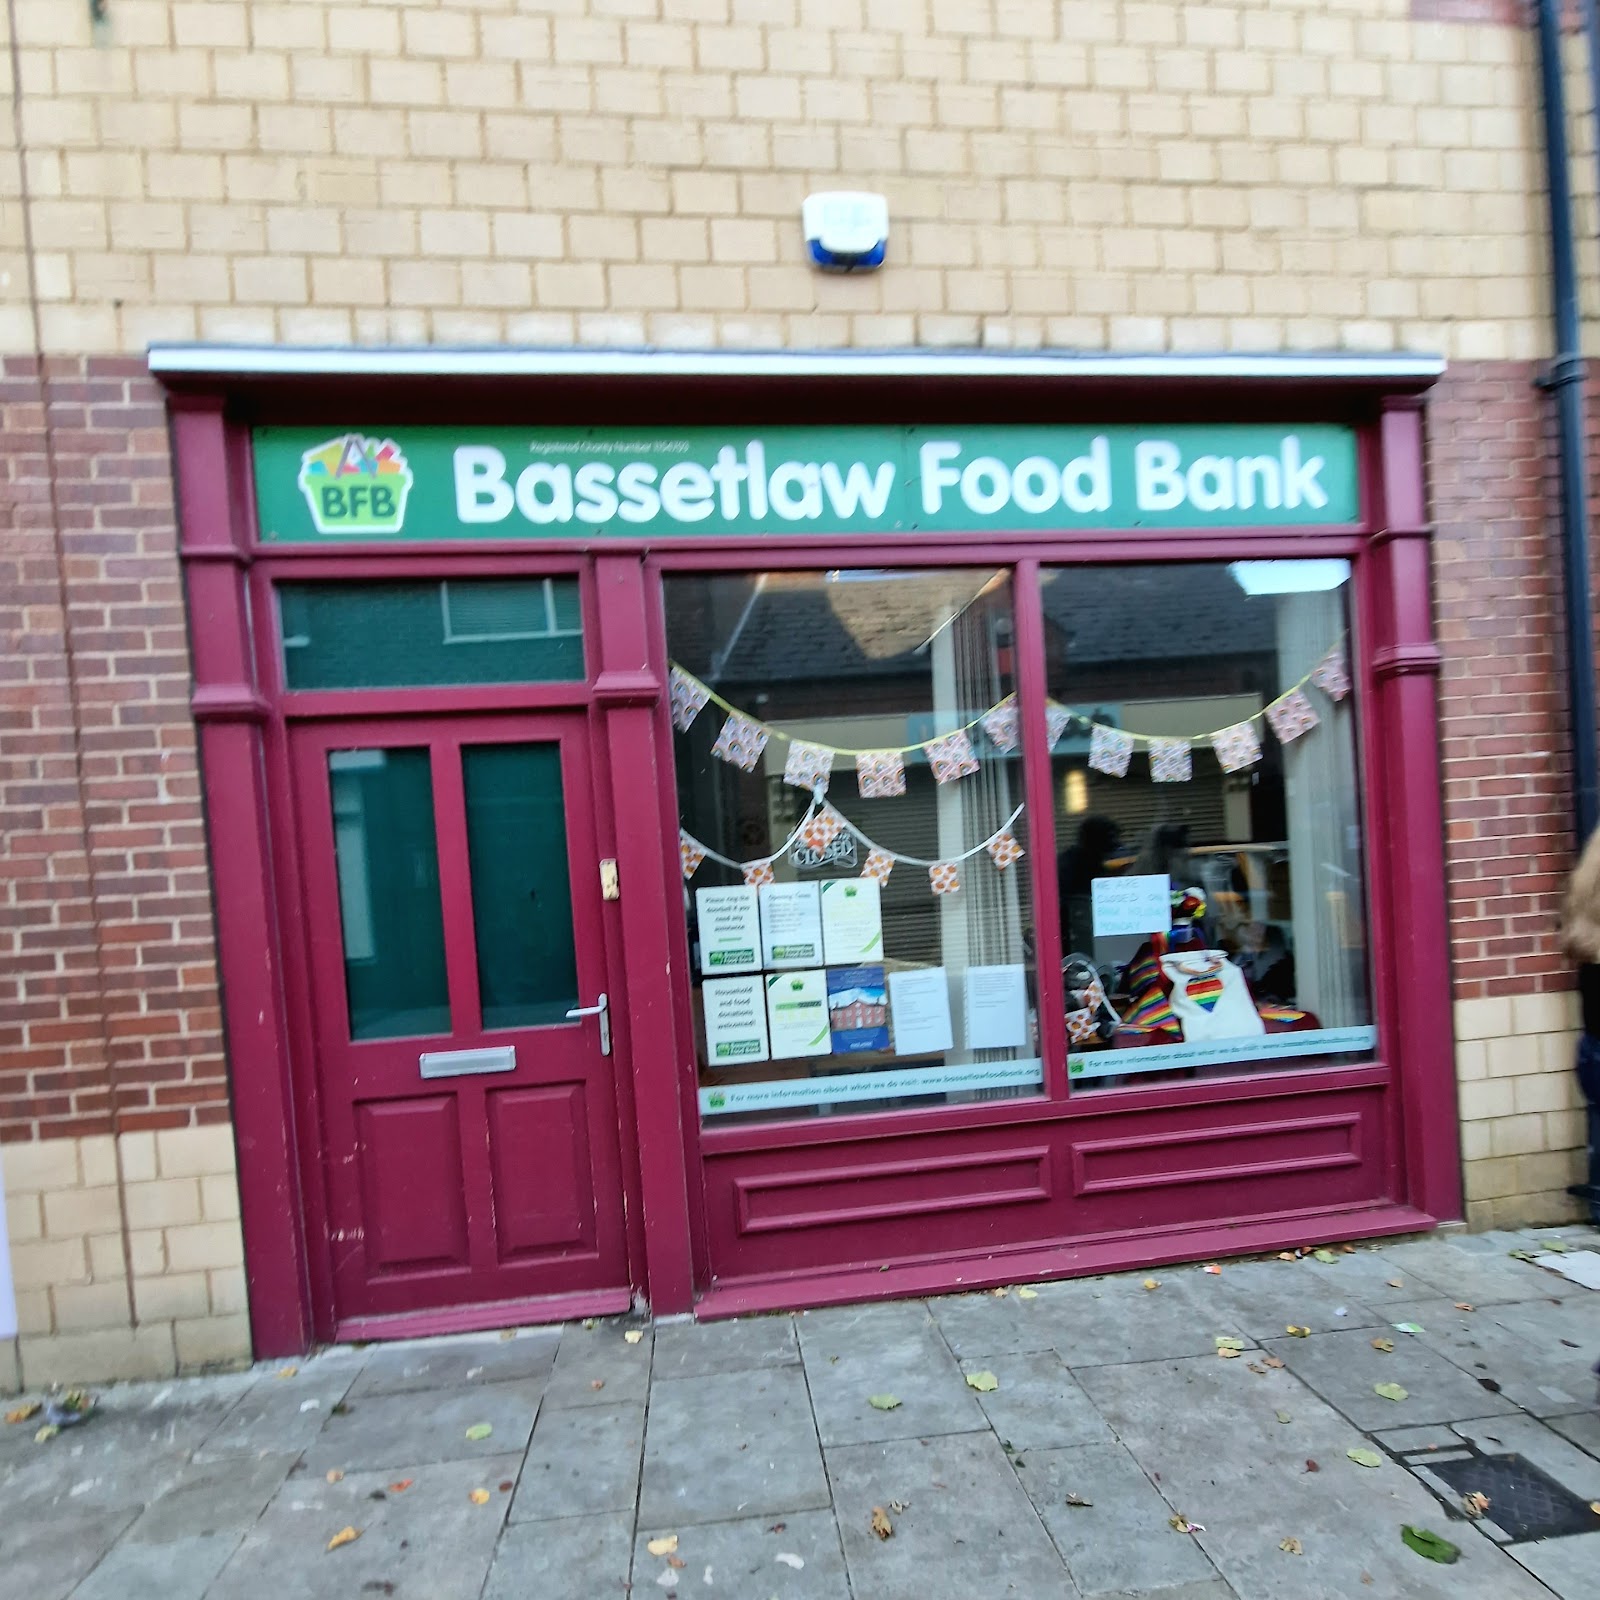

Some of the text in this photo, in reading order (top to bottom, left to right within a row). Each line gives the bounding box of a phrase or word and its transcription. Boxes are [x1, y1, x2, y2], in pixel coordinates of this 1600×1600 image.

[529, 440, 580, 455] Registered
[580, 440, 613, 455] Charity
[614, 440, 651, 453] Number
[452, 435, 1328, 523] Bassetlaw Food Bank
[321, 484, 396, 519] BFB
[715, 986, 753, 996] Household
[720, 999, 732, 1007] and
[718, 1010, 754, 1018] donations
[1088, 1060, 1102, 1068] For
[1103, 1059, 1124, 1067] more
[1126, 1053, 1171, 1064] information
[1173, 1051, 1195, 1060] about
[1197, 1049, 1217, 1057] what
[730, 1094, 745, 1102] For
[746, 1093, 769, 1101] more
[771, 1087, 821, 1099] information
[823, 1084, 848, 1094] about
[849, 1082, 872, 1092] what
